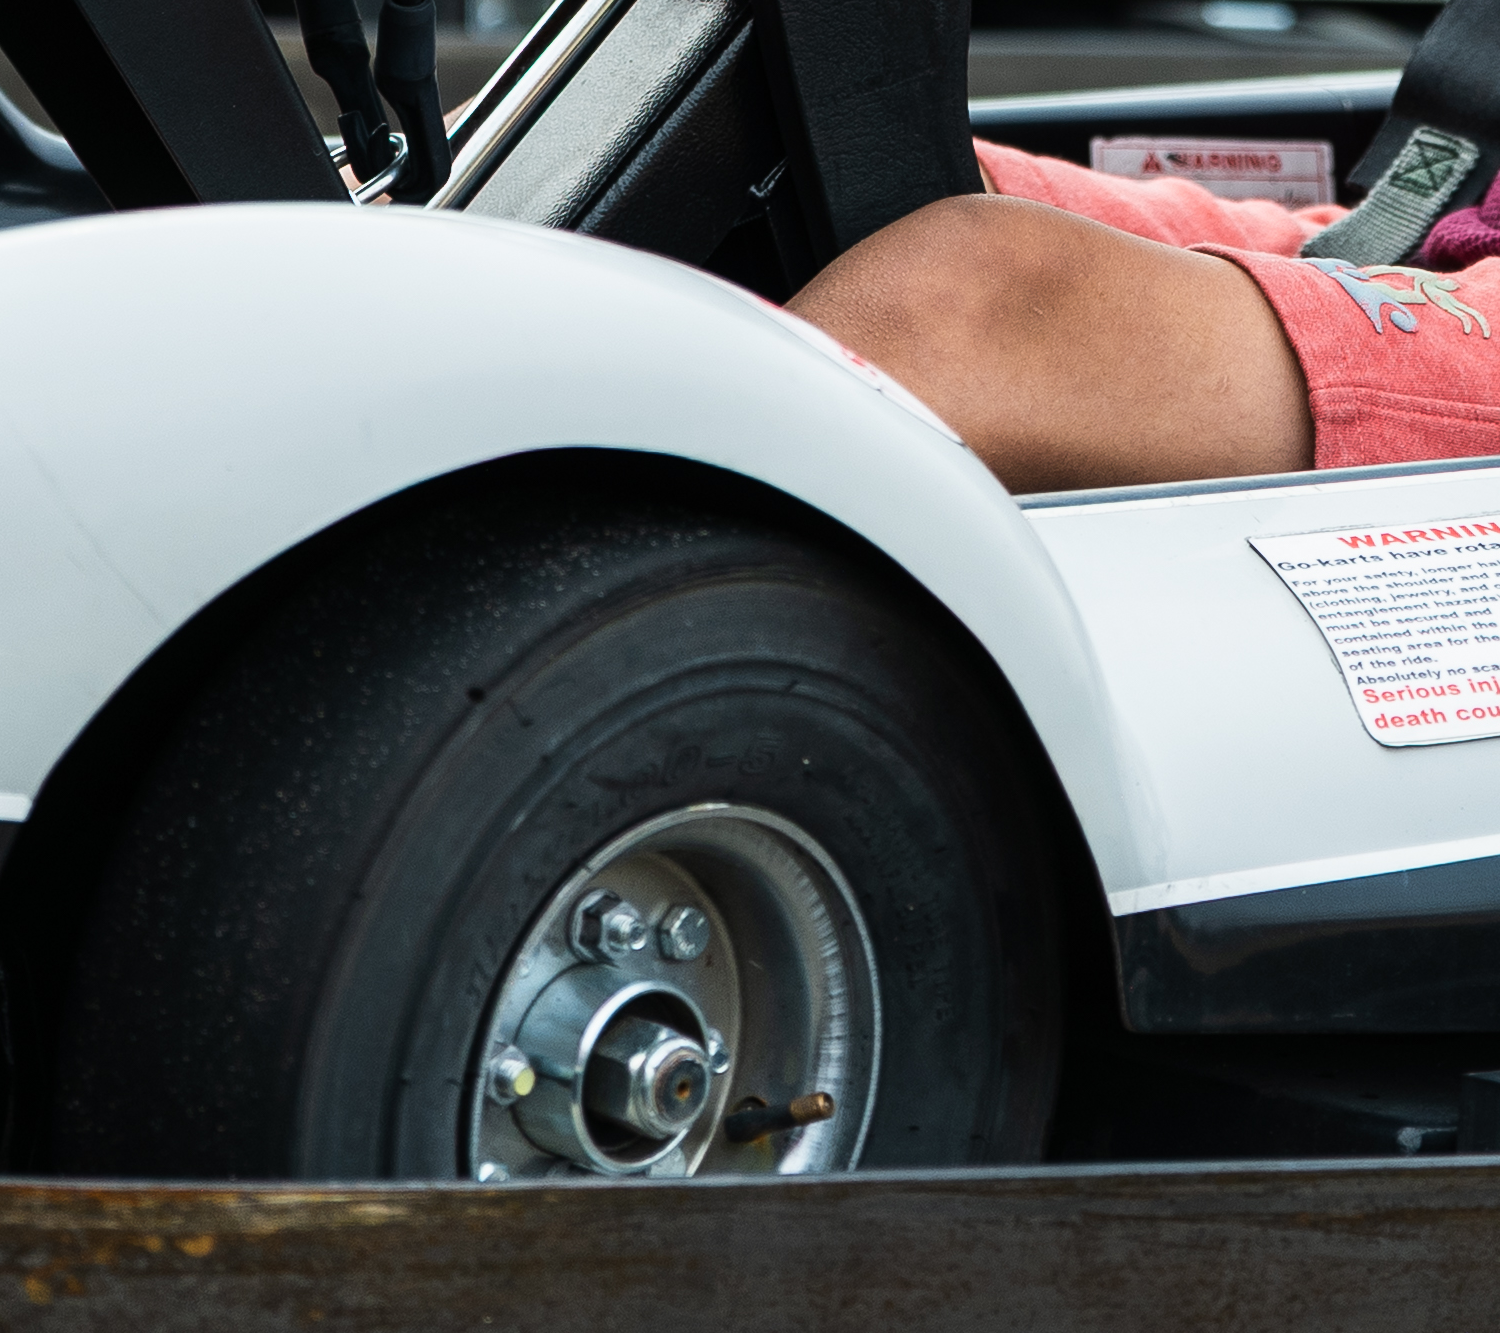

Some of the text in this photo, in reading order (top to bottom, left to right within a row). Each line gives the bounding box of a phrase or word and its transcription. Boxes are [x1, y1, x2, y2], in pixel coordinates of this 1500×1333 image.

[1277, 552, 1384, 572] Go-karts
[1388, 547, 1448, 561] have
[1291, 579, 1318, 588] For
[1323, 575, 1358, 587] your
[1363, 570, 1418, 580] safety,
[1422, 562, 1473, 575] longer
[1301, 587, 1349, 599] above
[1353, 583, 1381, 593] the
[1385, 576, 1455, 590] shoulder
[1461, 571, 1490, 582] and
[1308, 595, 1388, 611] (clothing,
[1391, 589, 1457, 604] jewelry,
[1460, 583, 1490, 594] and
[1317, 601, 1430, 621] entanglement
[1325, 607, 1493, 633] must be secured and
[1334, 619, 1499, 646] contained within the
[1341, 643, 1403, 658] seating
[1407, 640, 1443, 652] area
[1447, 636, 1470, 648] for
[1474, 633, 1500, 645] the
[1349, 654, 1439, 672] of the ride.
[1357, 667, 1442, 686] Absolutely
[1446, 665, 1468, 677] no
[1362, 683, 1462, 705] Serious
[1374, 707, 1448, 730] death
